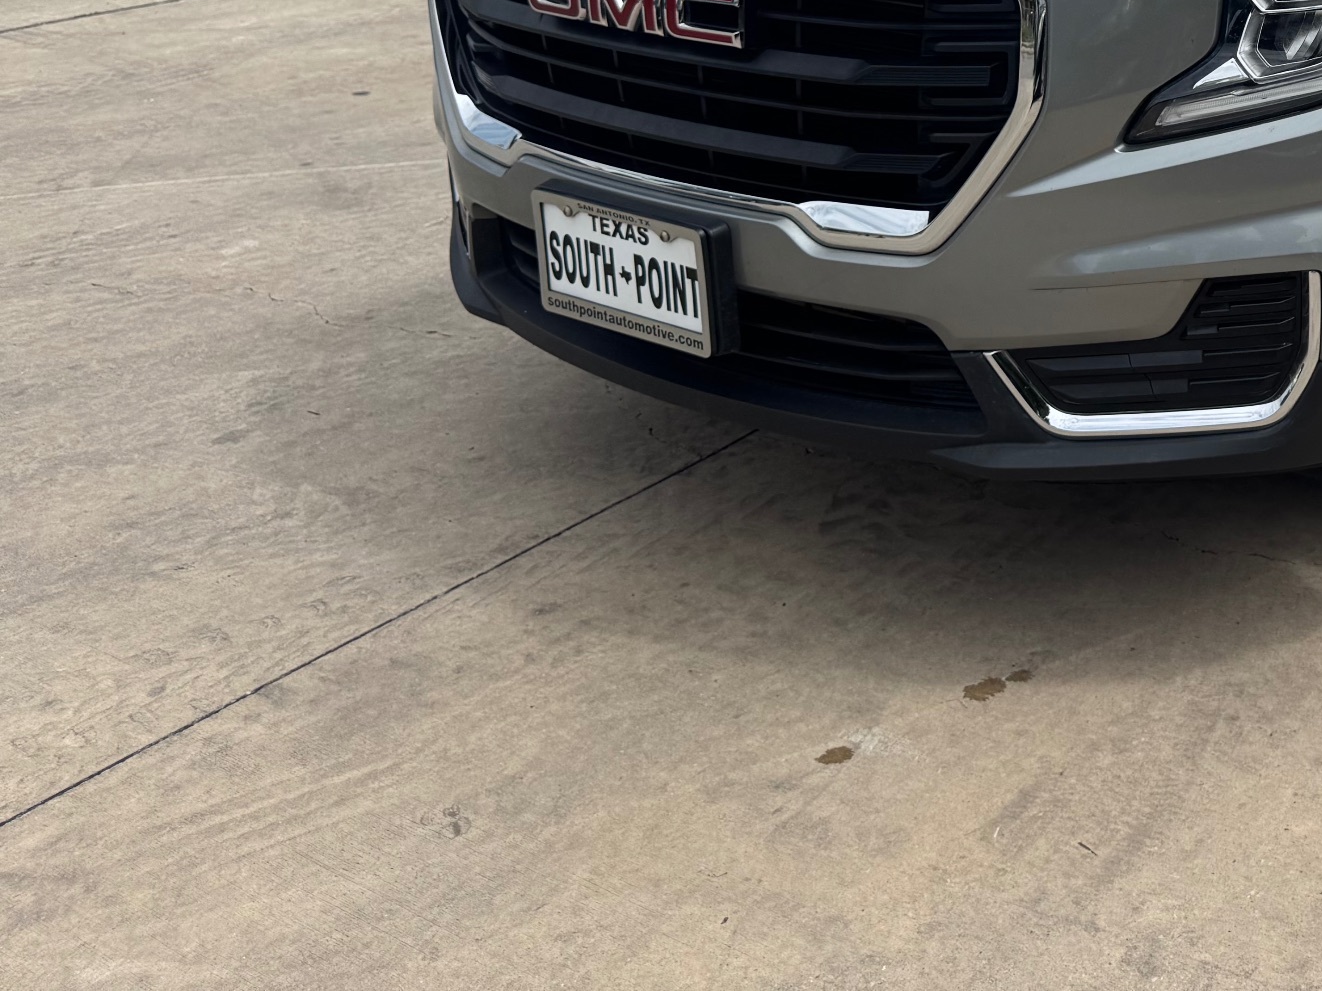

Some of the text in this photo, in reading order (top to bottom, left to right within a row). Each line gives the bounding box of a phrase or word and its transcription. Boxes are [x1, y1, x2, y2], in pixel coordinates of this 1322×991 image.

[588, 214, 650, 246] TEXAS
[549, 230, 699, 319] SOUTH POINT
[547, 296, 704, 351] southpointautomotive.com
